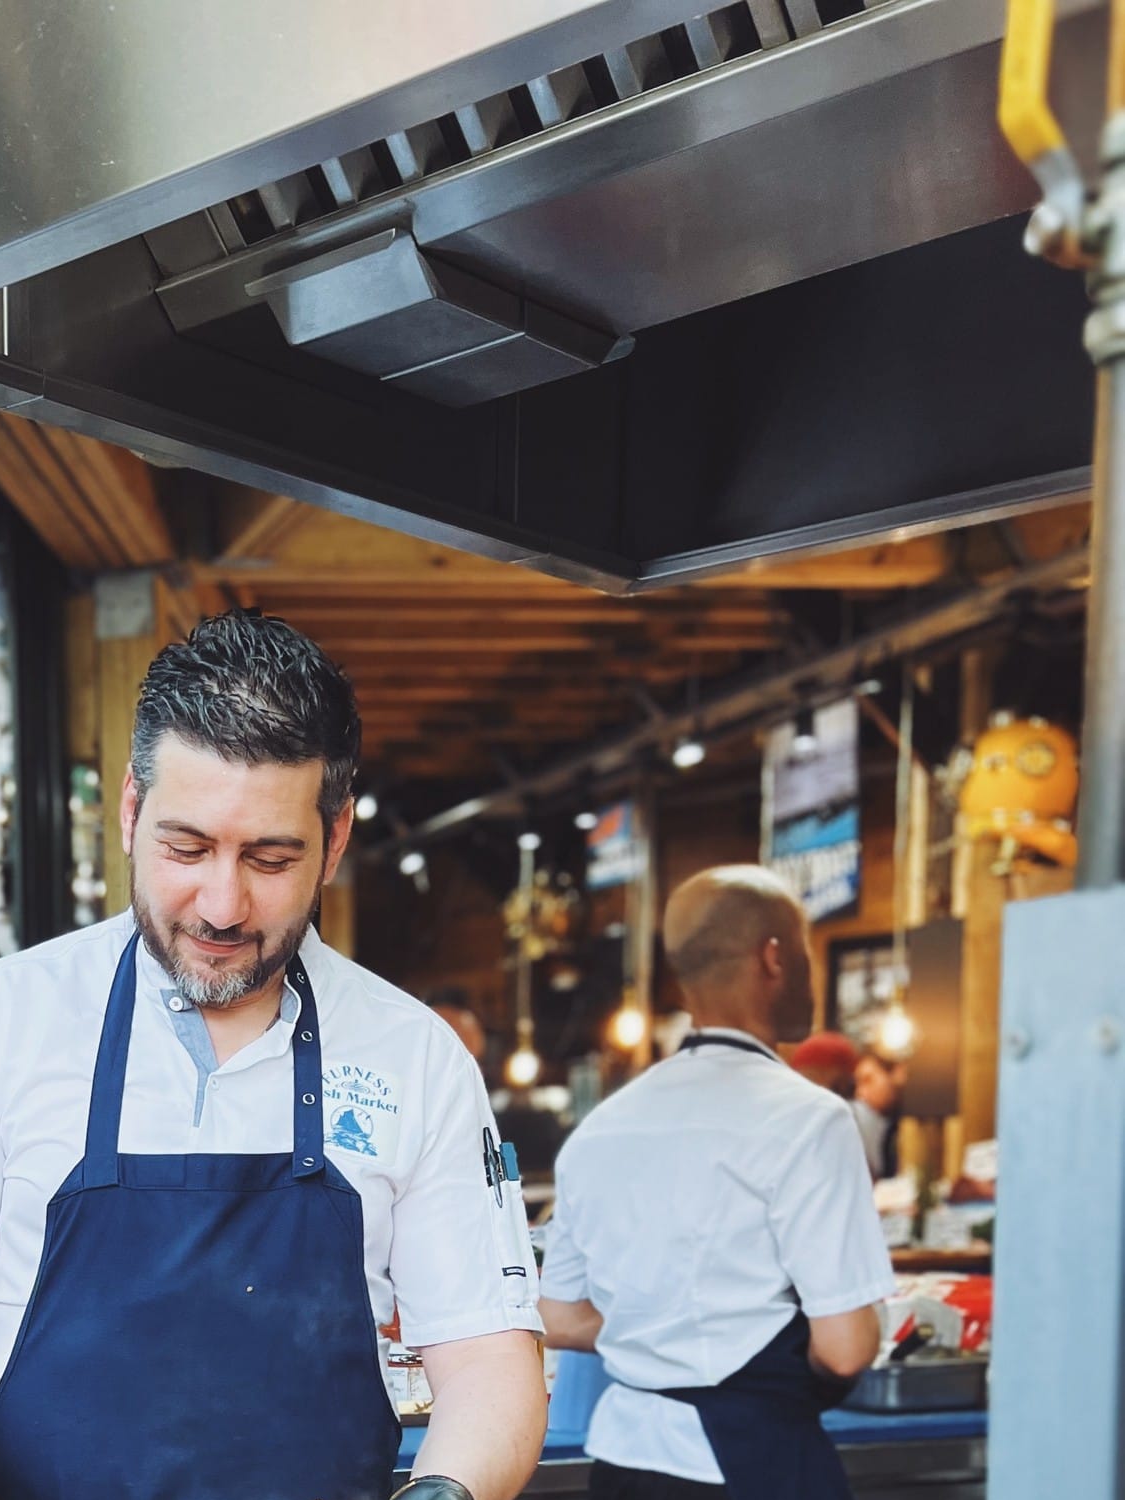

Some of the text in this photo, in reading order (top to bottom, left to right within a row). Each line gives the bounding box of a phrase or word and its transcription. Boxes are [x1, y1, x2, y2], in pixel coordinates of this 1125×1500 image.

[322, 1065, 391, 1096] FURNESS
[323, 1089, 398, 1114] sh Market
